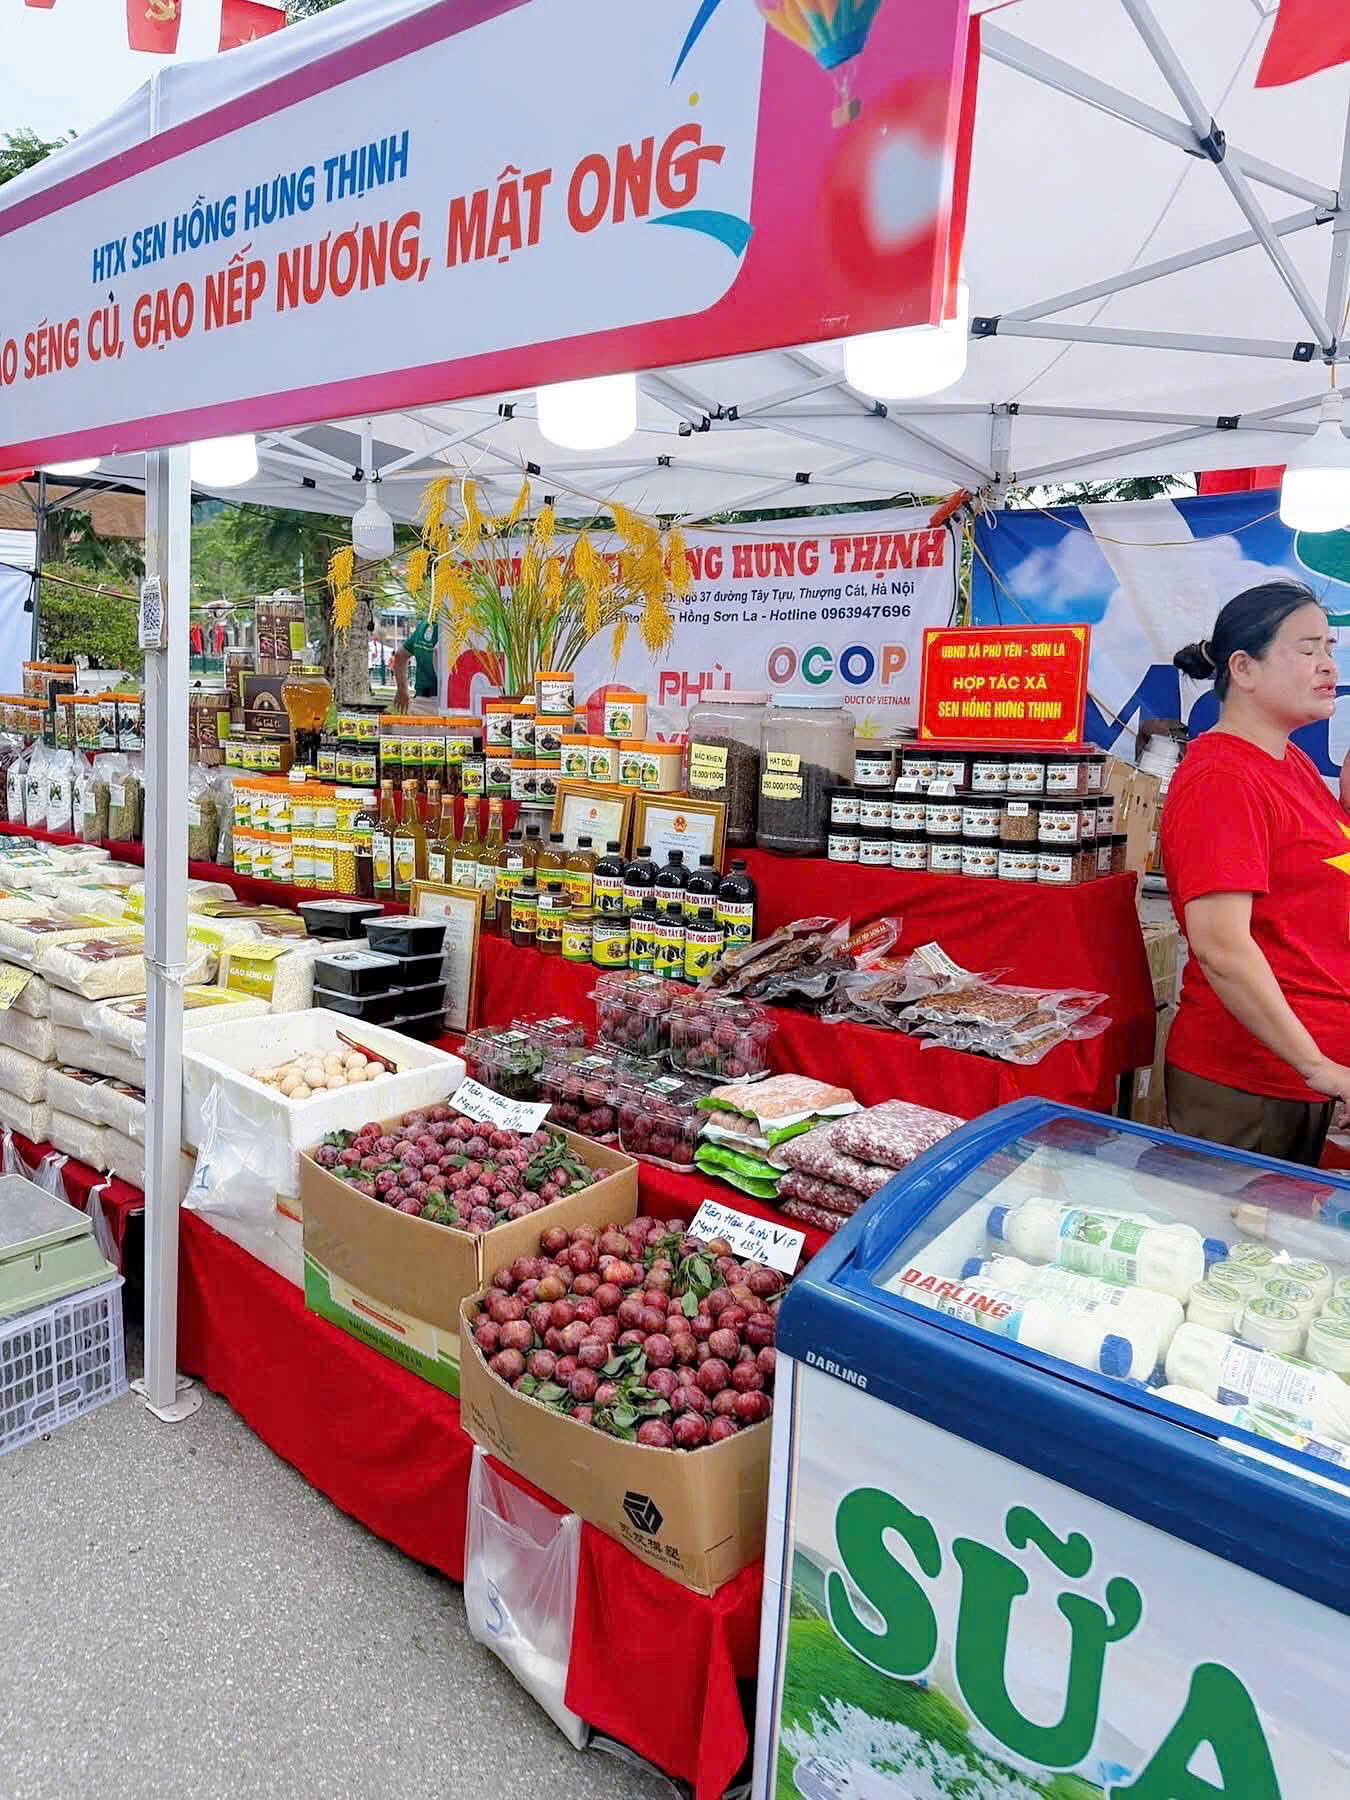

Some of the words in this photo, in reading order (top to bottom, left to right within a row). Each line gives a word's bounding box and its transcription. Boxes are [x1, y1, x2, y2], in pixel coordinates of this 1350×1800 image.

[92, 235, 126, 282] HTX
[132, 222, 166, 261] SEN
[173, 194, 236, 252] HỒNG
[244, 166, 316, 229] HƯNG
[324, 130, 409, 201] THỊNH
[24, 318, 80, 379] SÉNG
[133, 282, 194, 351] GẠO
[204, 244, 266, 331] NẾP
[276, 211, 431, 311] NƯƠNG,
[447, 164, 551, 269] MẬT
[568, 122, 703, 233] ONG
[667, 544, 723, 581] NG
[732, 540, 819, 578] HƯNG
[830, 529, 946, 579] THỊNH
[700, 590, 711, 602] 37
[714, 590, 748, 605] đường
[751, 589, 769, 604] Tây
[800, 586, 841, 604] Thượng
[845, 584, 868, 600] Cát,
[872, 583, 887, 596] Hà
[891, 582, 915, 596] Nội
[679, 609, 710, 625] Hồng
[713, 609, 738, 622] Sơn
[743, 609, 758, 622] La
[769, 608, 817, 622] Hotline
[821, 605, 911, 620] 0963947696
[767, 645, 907, 686] OCOP
[941, 645, 966, 659] UBND
[1053, 643, 1065, 657] LA
[844, 696, 865, 705] DUCT
[866, 696, 877, 705] OF
[877, 696, 911, 706] VIETNAM
[953, 675, 985, 692] HỢP
[989, 673, 1021, 689] TÁC
[1024, 673, 1048, 689] XÃ
[938, 701, 959, 718] SEN
[994, 701, 1024, 719] HƯNG
[1028, 701, 1062, 723] THỊNH
[901, 1268, 1012, 1319] DARLING
[804, 1351, 868, 1389] DARLING
[825, 1487, 1284, 1800] SỮA
